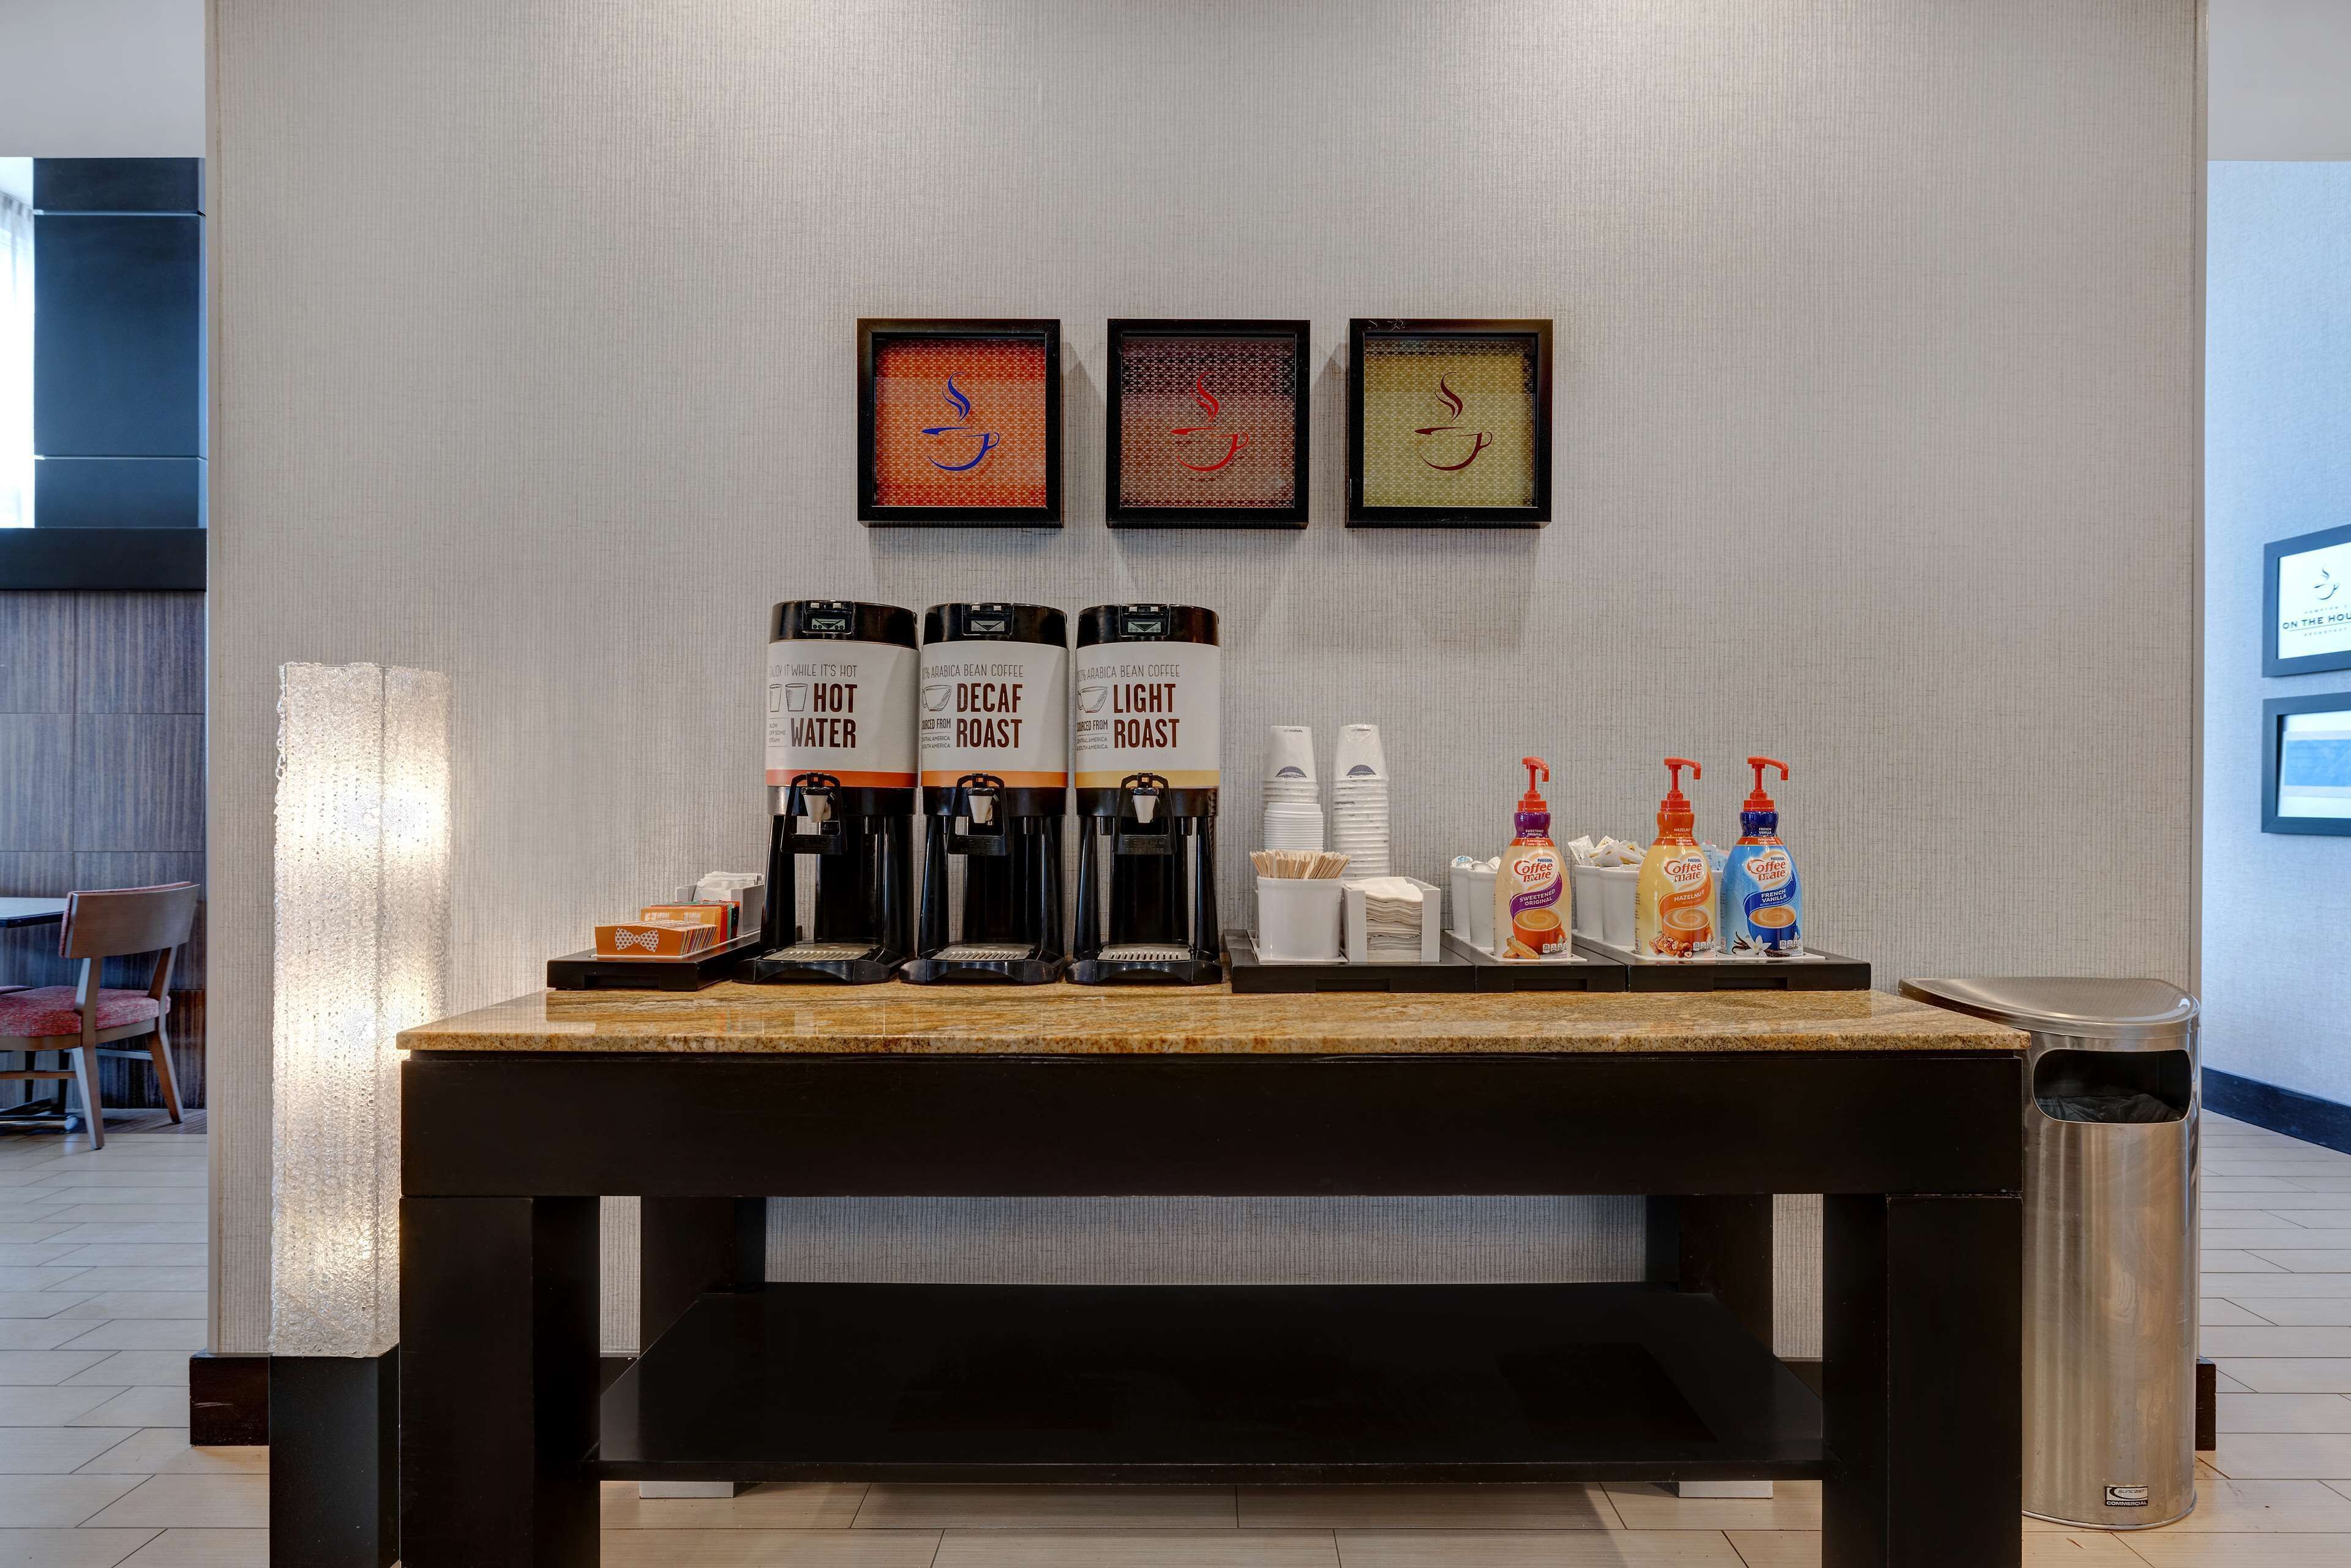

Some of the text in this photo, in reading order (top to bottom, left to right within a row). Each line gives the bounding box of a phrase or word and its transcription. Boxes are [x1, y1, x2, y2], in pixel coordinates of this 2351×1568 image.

[2282, 620, 2298, 629] ON
[2301, 617, 2323, 626] THE
[784, 664, 790, 677] IT
[791, 664, 817, 677] WHILE
[820, 664, 836, 677] IT'S
[840, 664, 857, 677] HOT
[931, 664, 961, 678] ARABICA
[964, 664, 987, 677] BEAN
[991, 664, 1024, 677] COFFEE
[1087, 666, 1117, 681] ARABICA
[1120, 664, 1144, 677] BEAN
[1148, 664, 1180, 677] COFFEE
[814, 683, 857, 713] HOT
[957, 683, 1023, 713] DECAF
[1114, 683, 1176, 713] LIGHT
[937, 718, 951, 729] FROM
[1093, 719, 1108, 730] FROM
[790, 718, 856, 748] WATER
[956, 718, 1022, 748] ROAST
[1114, 718, 1180, 749] ROAST
[1513, 860, 1553, 876] Coffee
[1664, 860, 1702, 876] Coffee
[1747, 859, 1786, 874] Coffee
[1523, 872, 1552, 882] mate
[1674, 872, 1700, 882] mate
[1758, 870, 1785, 881] mate
[1520, 889, 1555, 902] SWEETENED
[1674, 890, 1704, 902] HAZELNUT
[1761, 888, 1786, 899] FRENCH
[1761, 894, 1787, 903] VANILLA
[1524, 896, 1553, 906] ORIGINAL
